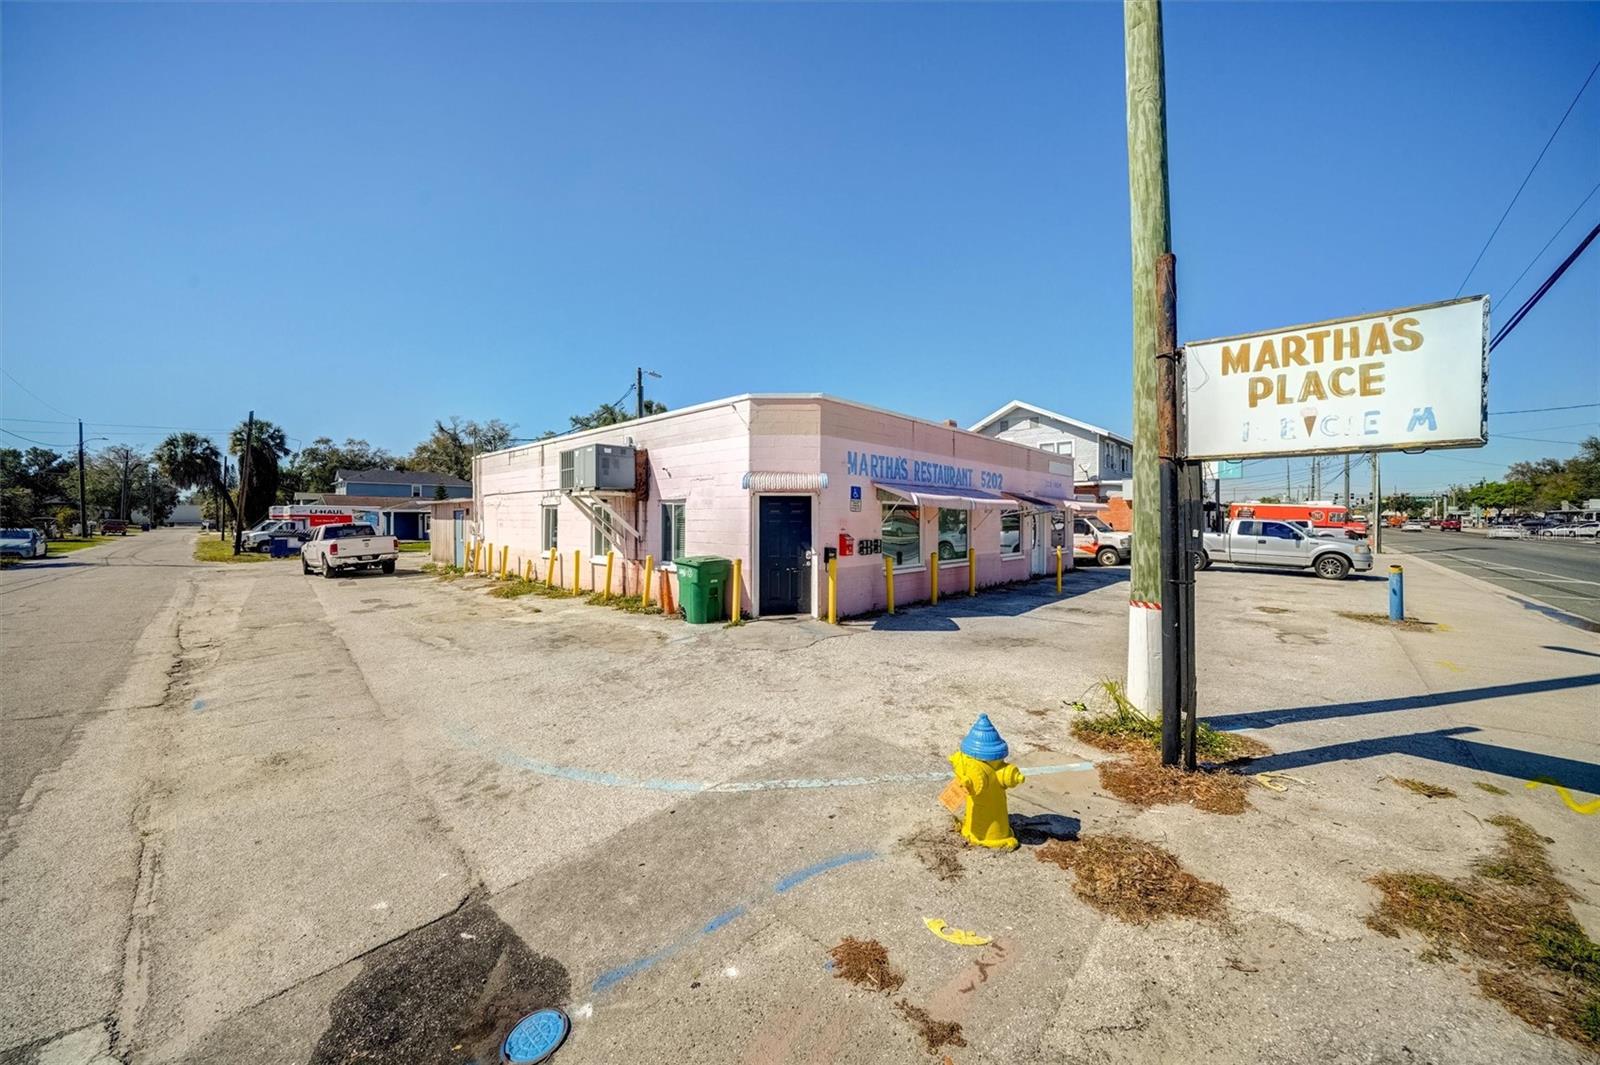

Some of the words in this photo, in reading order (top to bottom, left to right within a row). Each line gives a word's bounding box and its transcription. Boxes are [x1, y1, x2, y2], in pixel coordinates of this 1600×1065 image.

[1221, 316, 1424, 376] MARTHA'S
[1248, 361, 1386, 408] PLACE
[847, 451, 908, 480] MARTHA'S
[914, 460, 973, 488] RESTAURANT
[980, 471, 1003, 490] 5202
